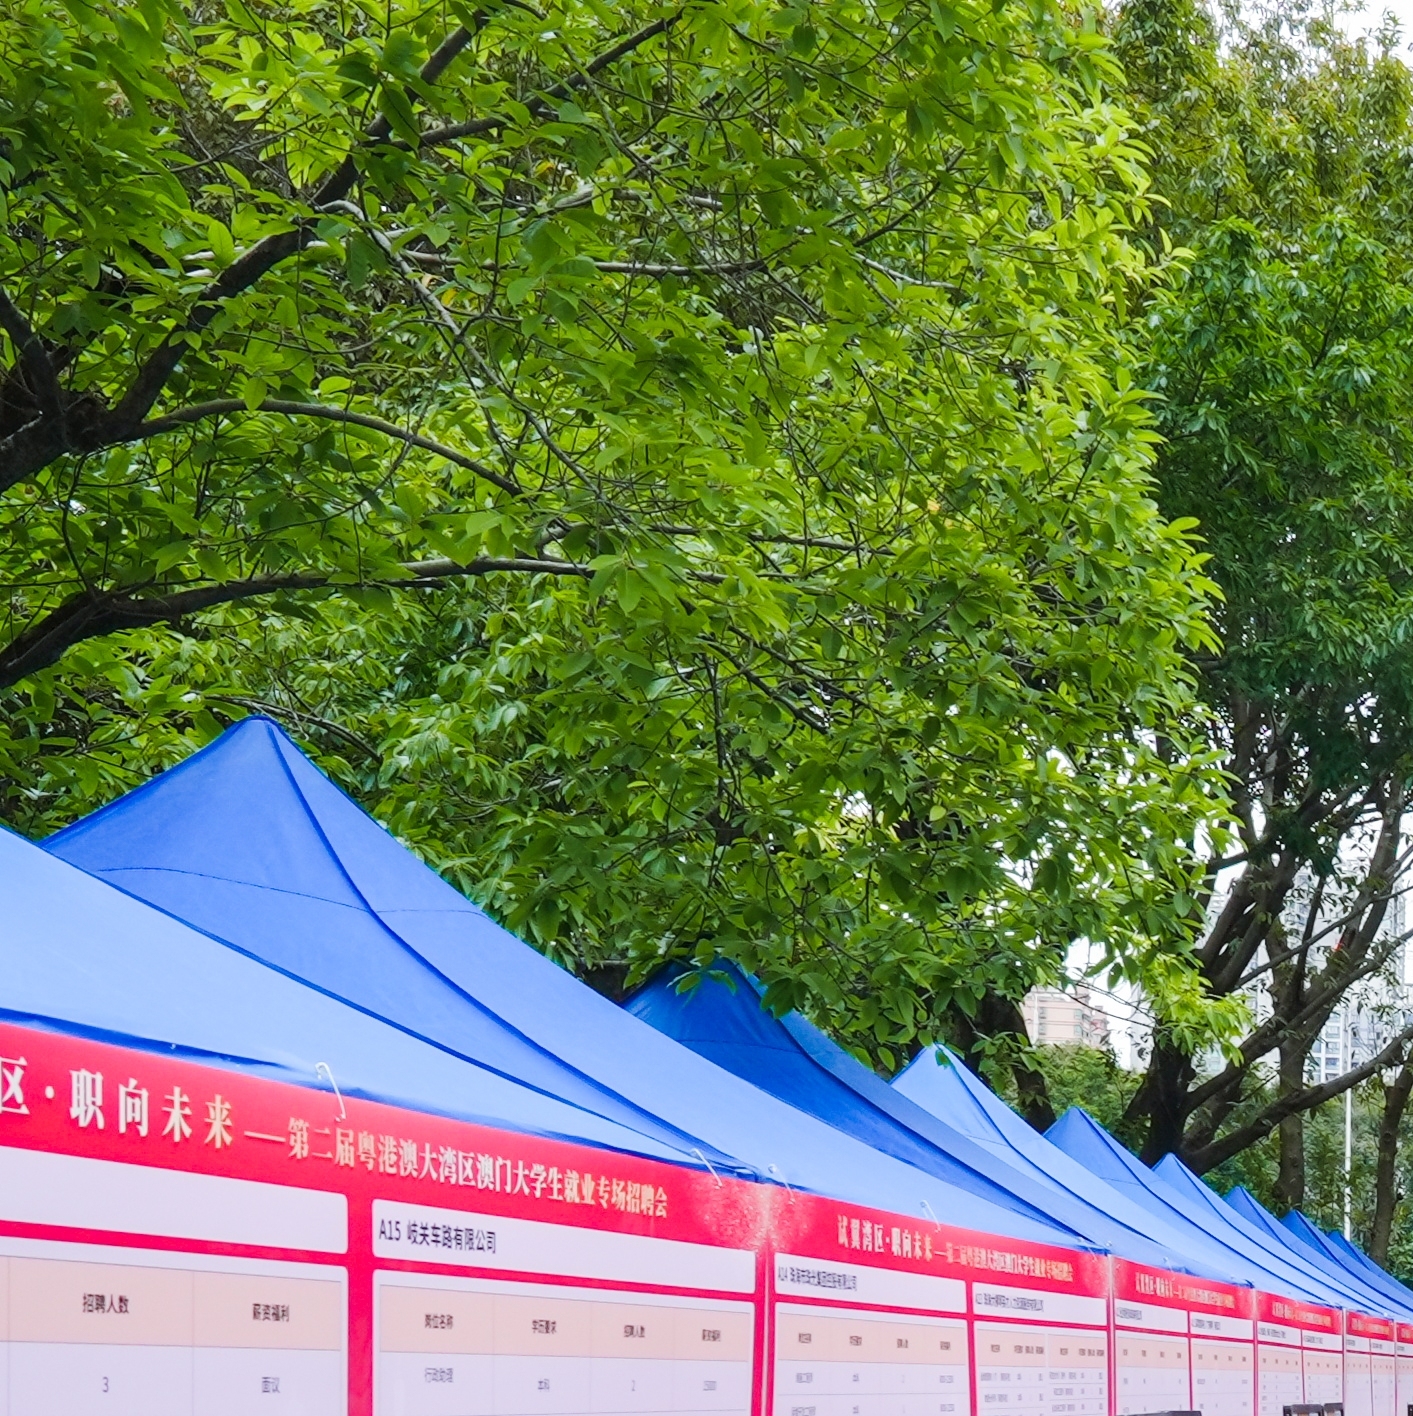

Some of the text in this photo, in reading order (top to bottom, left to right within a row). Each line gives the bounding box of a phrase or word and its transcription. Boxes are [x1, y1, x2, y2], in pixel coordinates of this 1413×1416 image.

[379, 1219, 496, 1254] A15 岐关车路有限公司
[82, 1293, 130, 1314] 招聘人数
[102, 1376, 281, 1394] 3 面议
